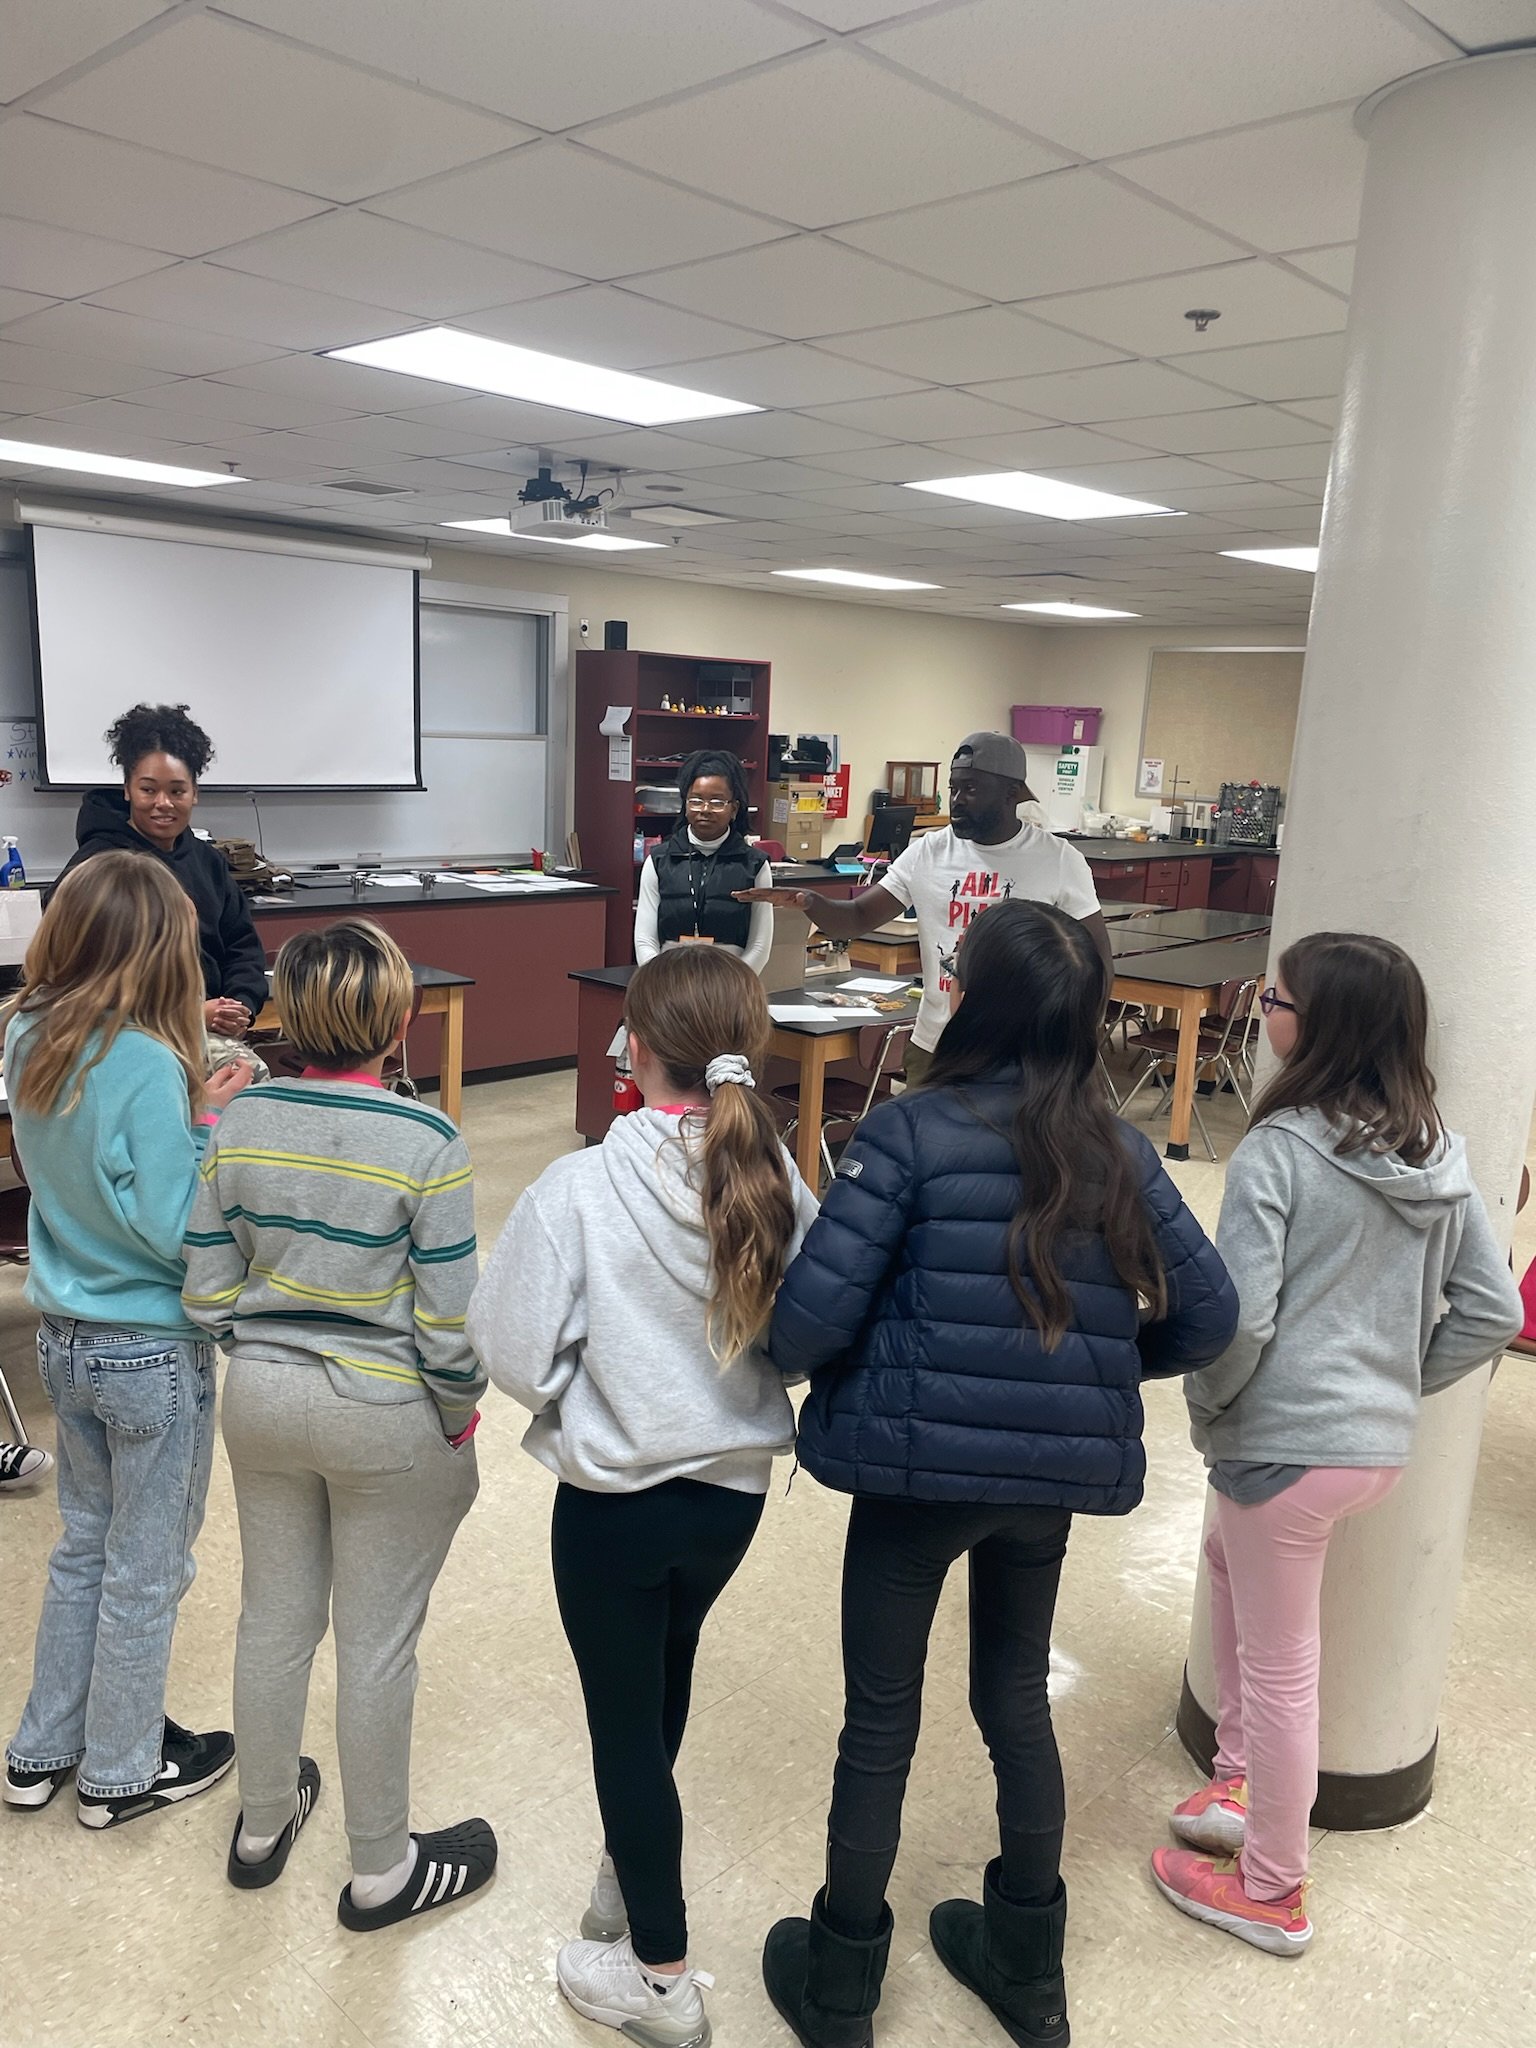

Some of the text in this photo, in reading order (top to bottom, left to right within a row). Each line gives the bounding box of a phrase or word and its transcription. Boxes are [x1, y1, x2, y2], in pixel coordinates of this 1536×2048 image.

[10, 723, 37, 741] St
[15, 747, 38, 759] Win
[1058, 762, 1077, 770] SAFETY
[960, 872, 1001, 897] ALL
